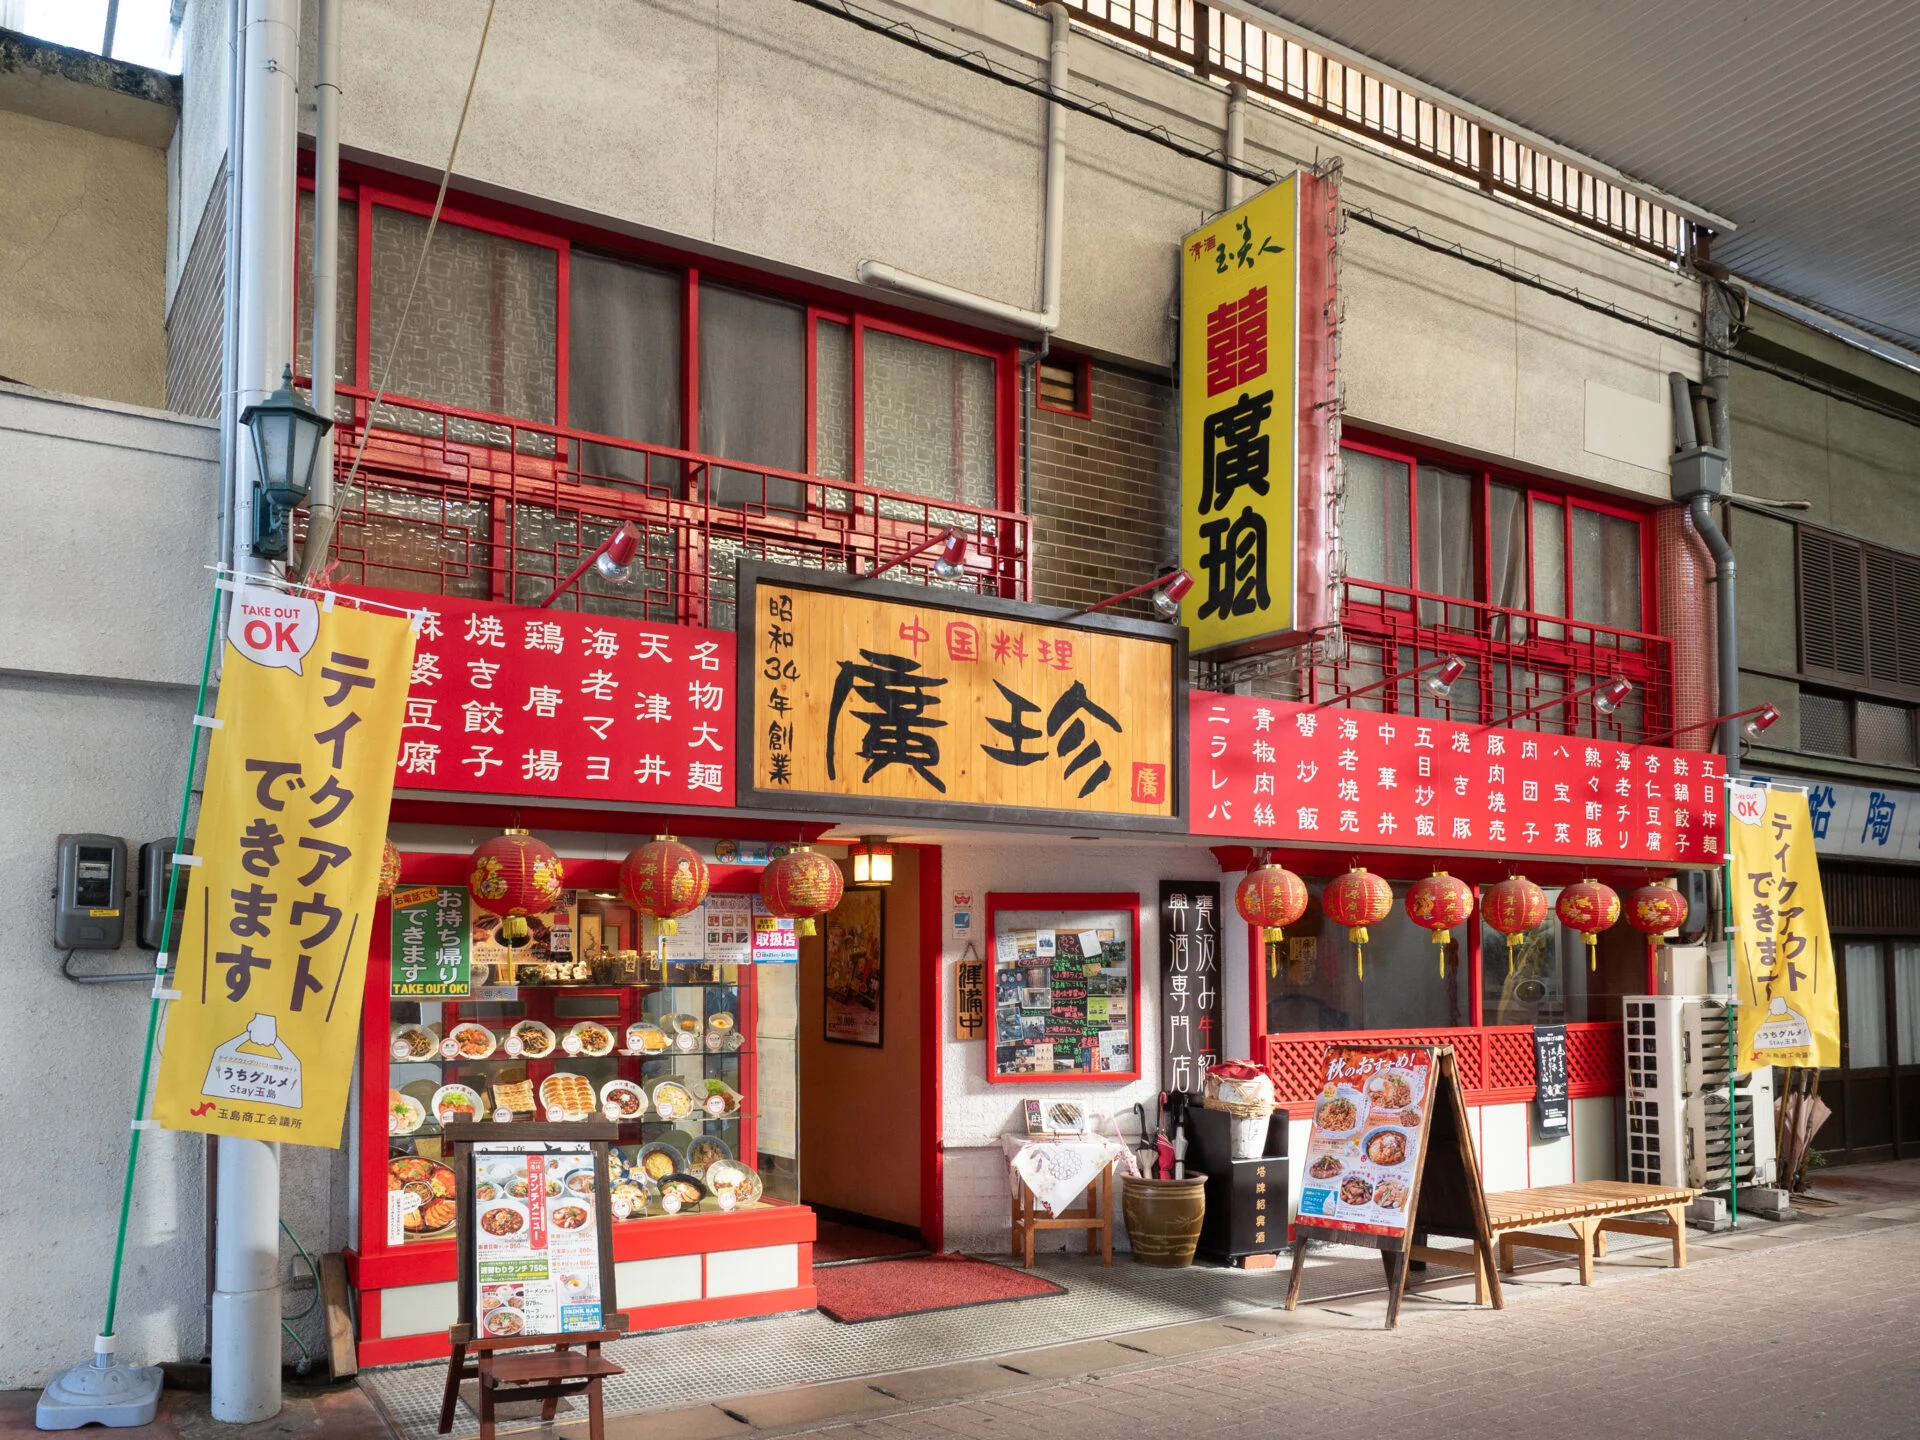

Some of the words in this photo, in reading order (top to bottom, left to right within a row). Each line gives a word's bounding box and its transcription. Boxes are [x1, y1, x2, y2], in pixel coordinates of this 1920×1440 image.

[241, 604, 270, 618] TAKE
[273, 605, 301, 620] OUT
[243, 620, 301, 654] OK
[899, 614, 1075, 671] 中国料理
[398, 606, 445, 776] 麻婆豆腐
[460, 611, 506, 777] 焼き餃子
[521, 620, 565, 782] 鶏唐揚
[580, 625, 620, 781] 海老マヨ
[633, 632, 673, 785] 天津丼
[687, 640, 724, 793] 名物大麺
[764, 594, 801, 785] 昭和34年創業
[825, 647, 1123, 799] 廣珍
[1207, 706, 1233, 821] ニラレバ
[1252, 707, 1277, 828] 青椒肉絲
[1295, 712, 1320, 831] 蟹炒飯
[1337, 716, 1360, 833] 海老焼売
[1376, 721, 1398, 836] 中華丼
[1414, 726, 1436, 837] 五目炒飯
[1451, 730, 1472, 840] 焼き豚
[1486, 734, 1507, 842] 豚肉焼売
[1520, 739, 1540, 844] 肉団子
[1552, 744, 1571, 845] 八宝菜
[1584, 746, 1603, 848] 熱々酢豚
[1614, 750, 1633, 850] 海老チリ
[1644, 753, 1662, 852] 杏仁豆腐
[1673, 757, 1690, 853] 鉄鍋餃子
[1700, 760, 1718, 854] 五目炸麺
[1737, 800, 1759, 817] OK
[214, 758, 307, 1003] できます
[288, 651, 376, 1013] テイクアウト
[393, 888, 438, 905] お電話でも
[400, 908, 429, 983] できます
[435, 890, 463, 985] お持ち帰り
[755, 932, 796, 947] 取扱店
[1770, 812, 1808, 992] テイクアウト
[393, 983, 425, 994] TAKE
[425, 983, 448, 994] OUT
[449, 983, 468, 994] OK!
[959, 963, 984, 1037] 準備中
[1762, 1028, 1803, 1040] うちグルメ
[223, 1066, 289, 1088] うちグルメ
[229, 1084, 277, 1100] Stay玉島
[1326, 1053, 1416, 1081] 秋のおすすめ!
[217, 1107, 303, 1129] 玉島商工会議所
[529, 1172, 541, 1241] ランチメニュー
